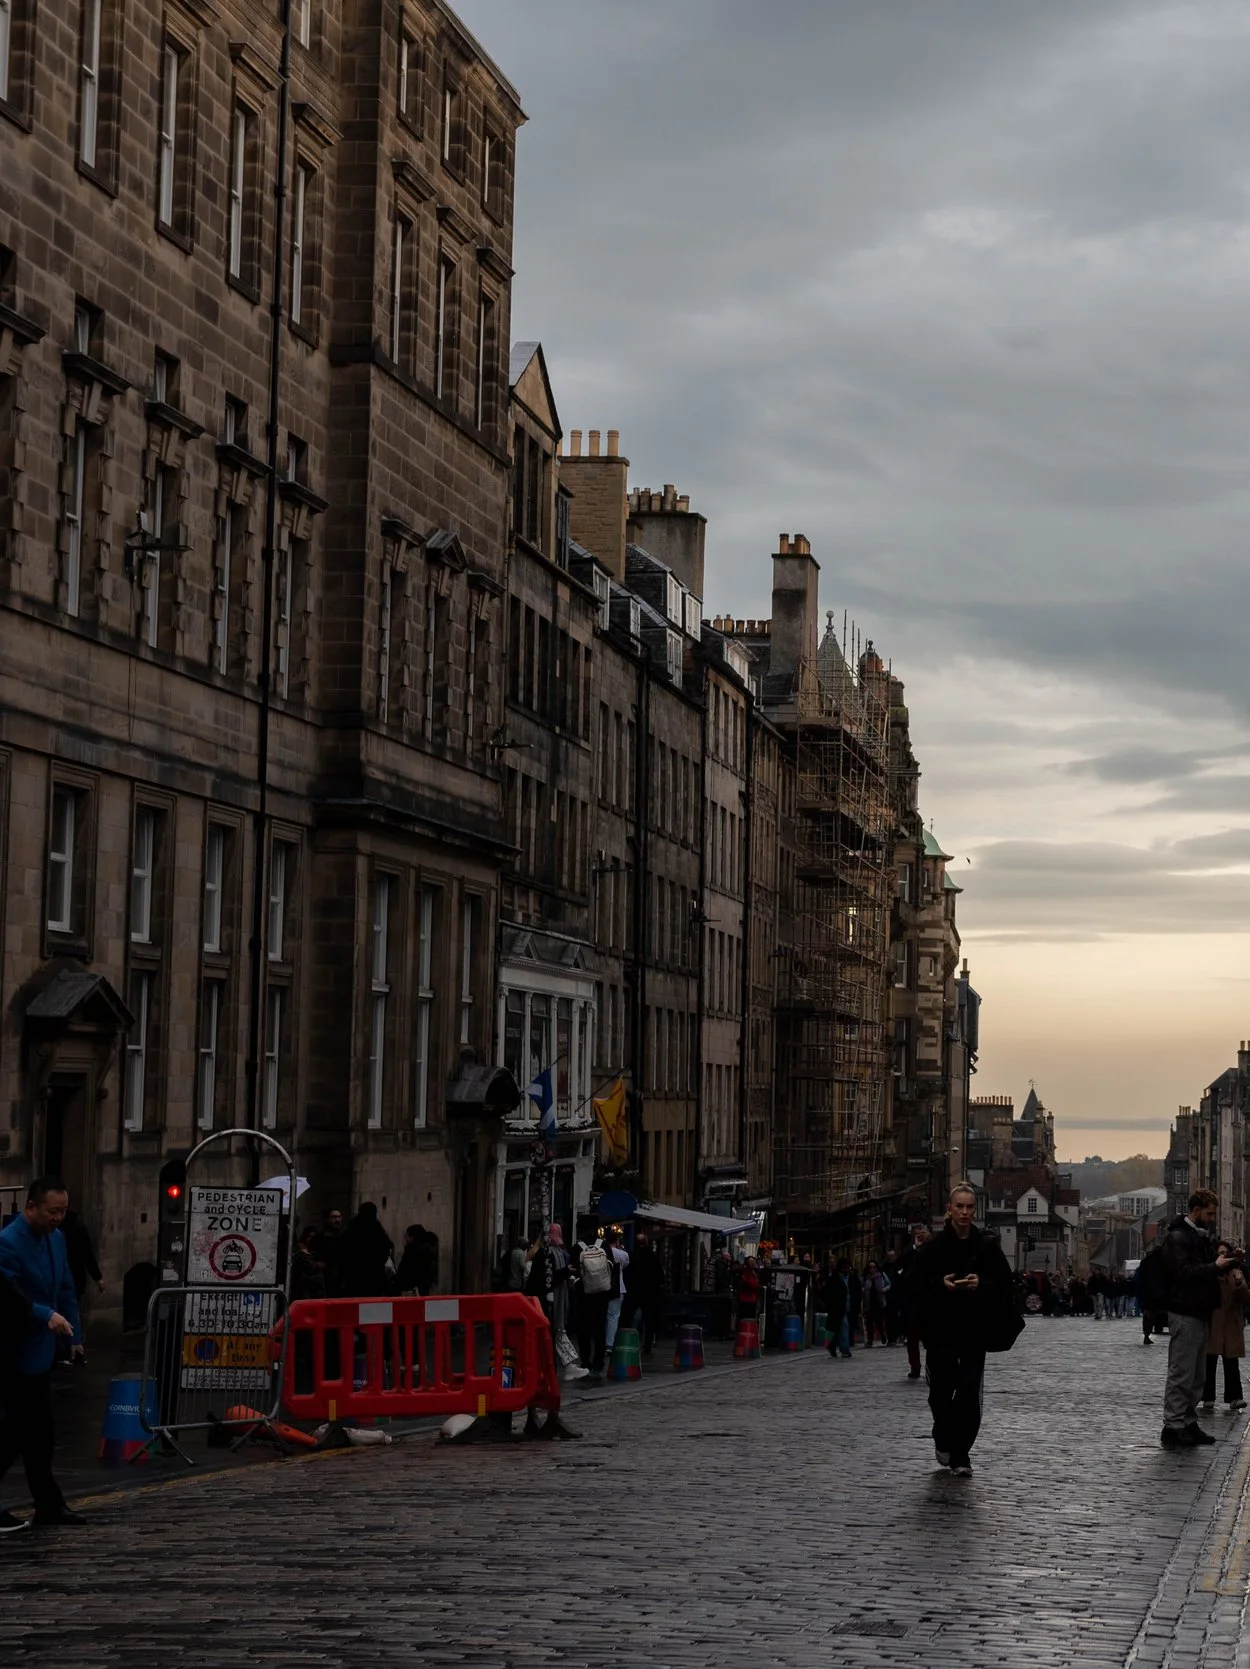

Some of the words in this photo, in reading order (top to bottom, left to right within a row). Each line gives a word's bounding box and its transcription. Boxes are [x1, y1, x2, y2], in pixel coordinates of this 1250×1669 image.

[197, 1192, 275, 1203] PEDESTRIAN
[204, 1204, 225, 1214] and
[227, 1205, 266, 1215] CYCLE
[208, 1216, 262, 1231] ZONE
